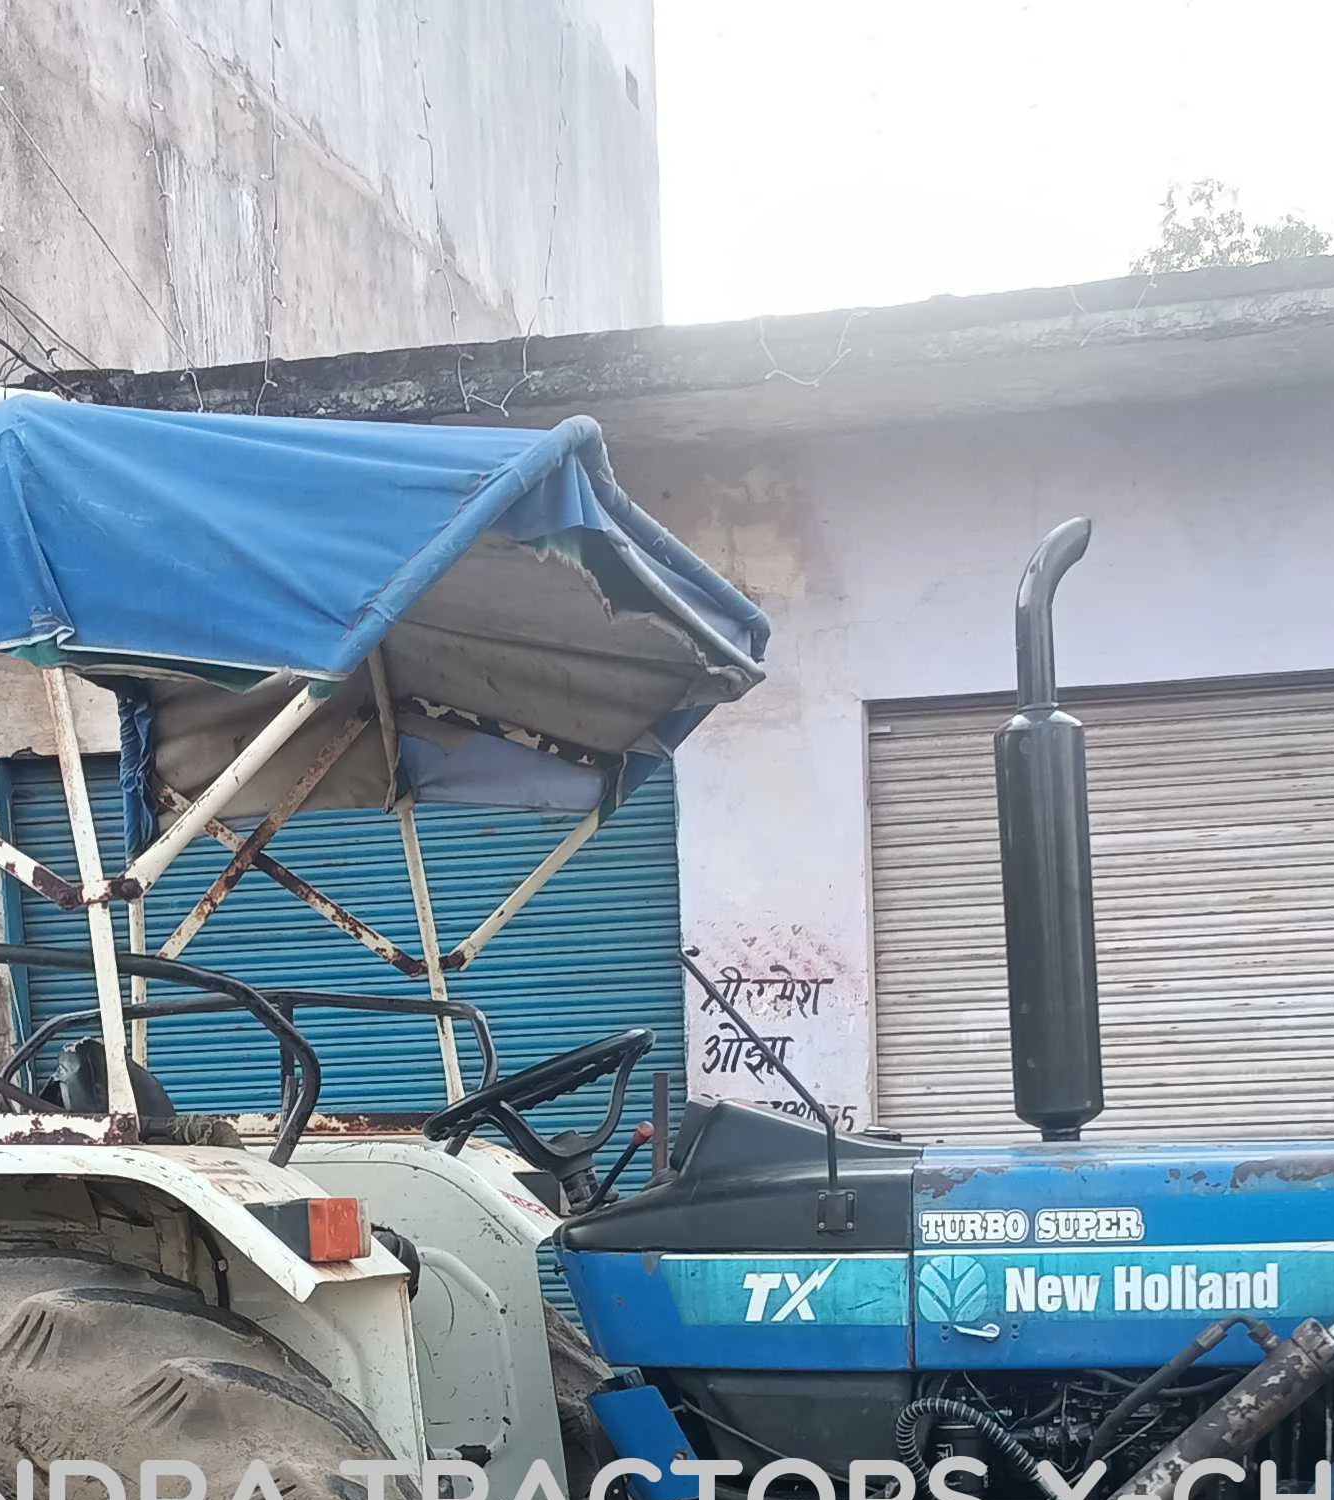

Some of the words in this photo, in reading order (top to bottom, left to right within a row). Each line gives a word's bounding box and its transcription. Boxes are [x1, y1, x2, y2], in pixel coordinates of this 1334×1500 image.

[921, 1209, 1029, 1244] TURBO
[1035, 1207, 1145, 1243] SUPER
[743, 1258, 842, 1321] TX
[1005, 1266, 1101, 1313] New
[1114, 1262, 1279, 1312] Holland
